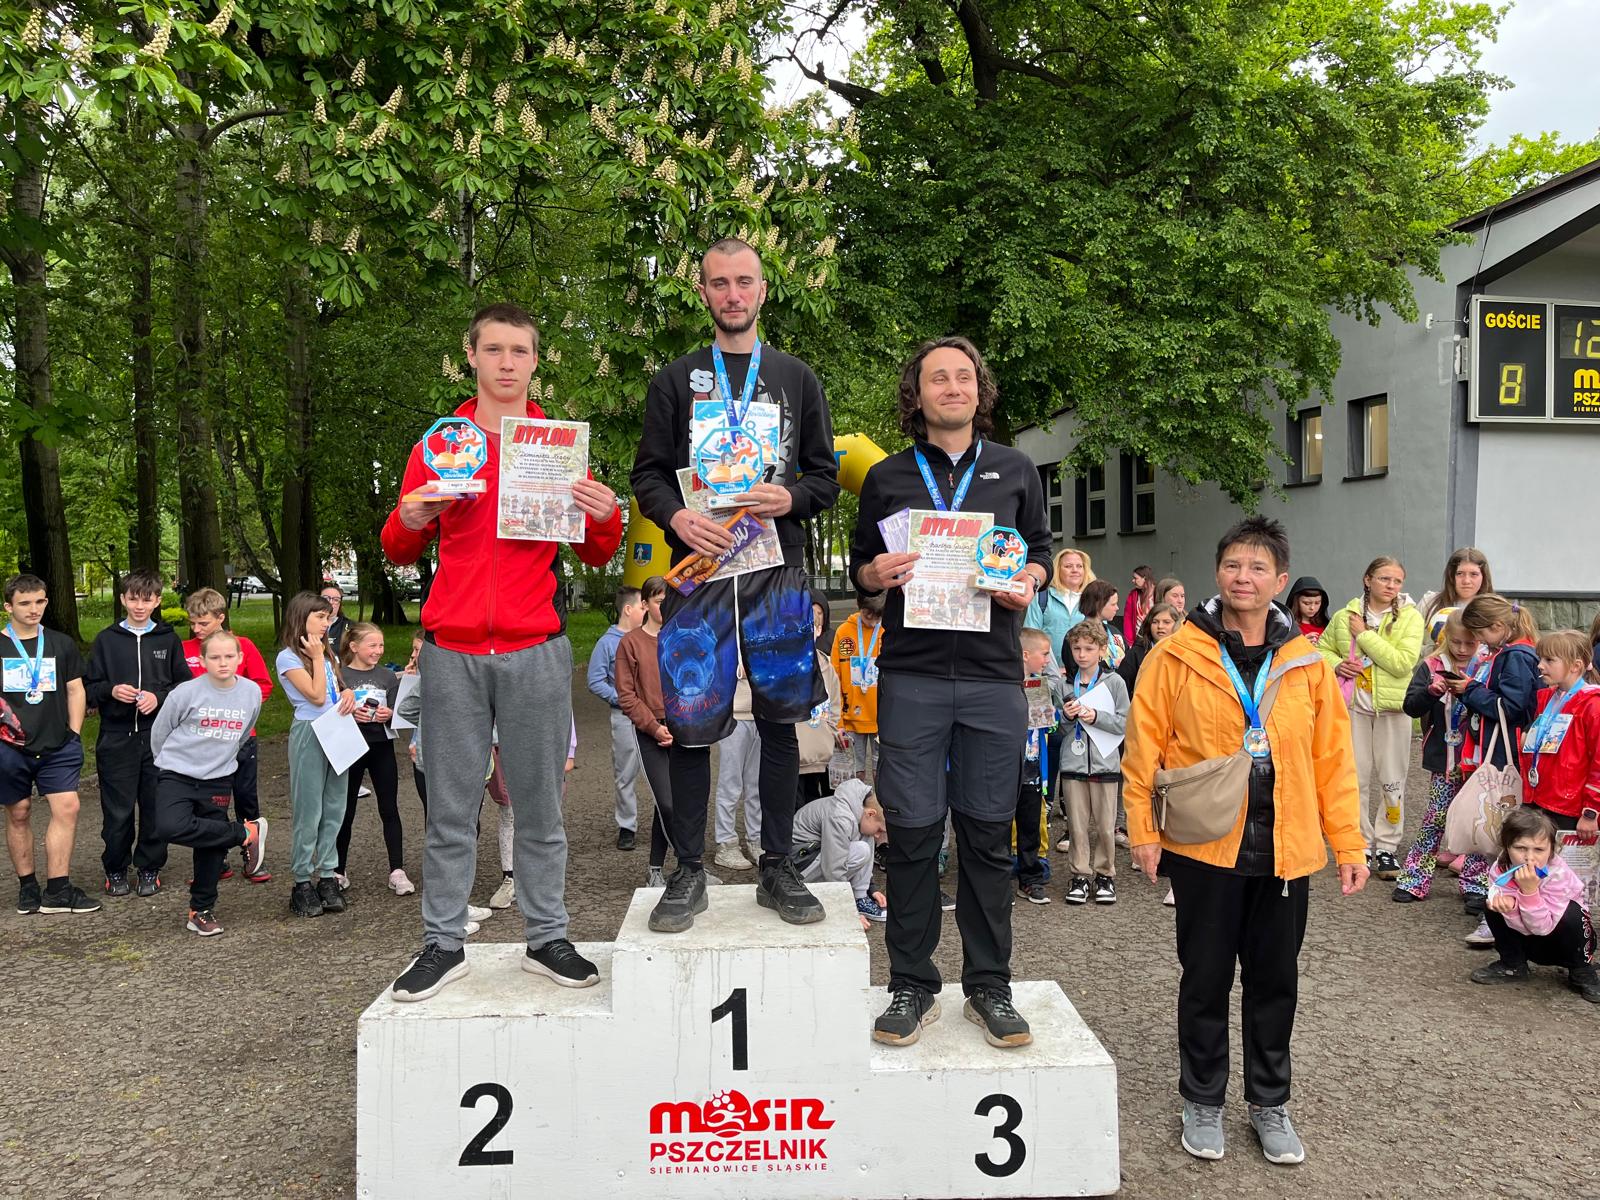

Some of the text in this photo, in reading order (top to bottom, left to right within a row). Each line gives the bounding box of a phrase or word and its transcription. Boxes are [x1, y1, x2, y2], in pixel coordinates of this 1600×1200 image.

[1485, 310, 1541, 329] GOŚCIE
[1499, 365, 1523, 404] 8
[512, 425, 577, 447] DYPLOM
[919, 517, 983, 537] DYPLOM
[198, 706, 246, 719] street
[200, 717, 242, 730] dance
[711, 988, 749, 1071] 1
[459, 1083, 514, 1166] 2
[974, 1093, 1027, 1178] 3
[650, 1138, 828, 1163] PSZCZELNIK
[650, 1164, 758, 1175] SIEMIANOWICE
